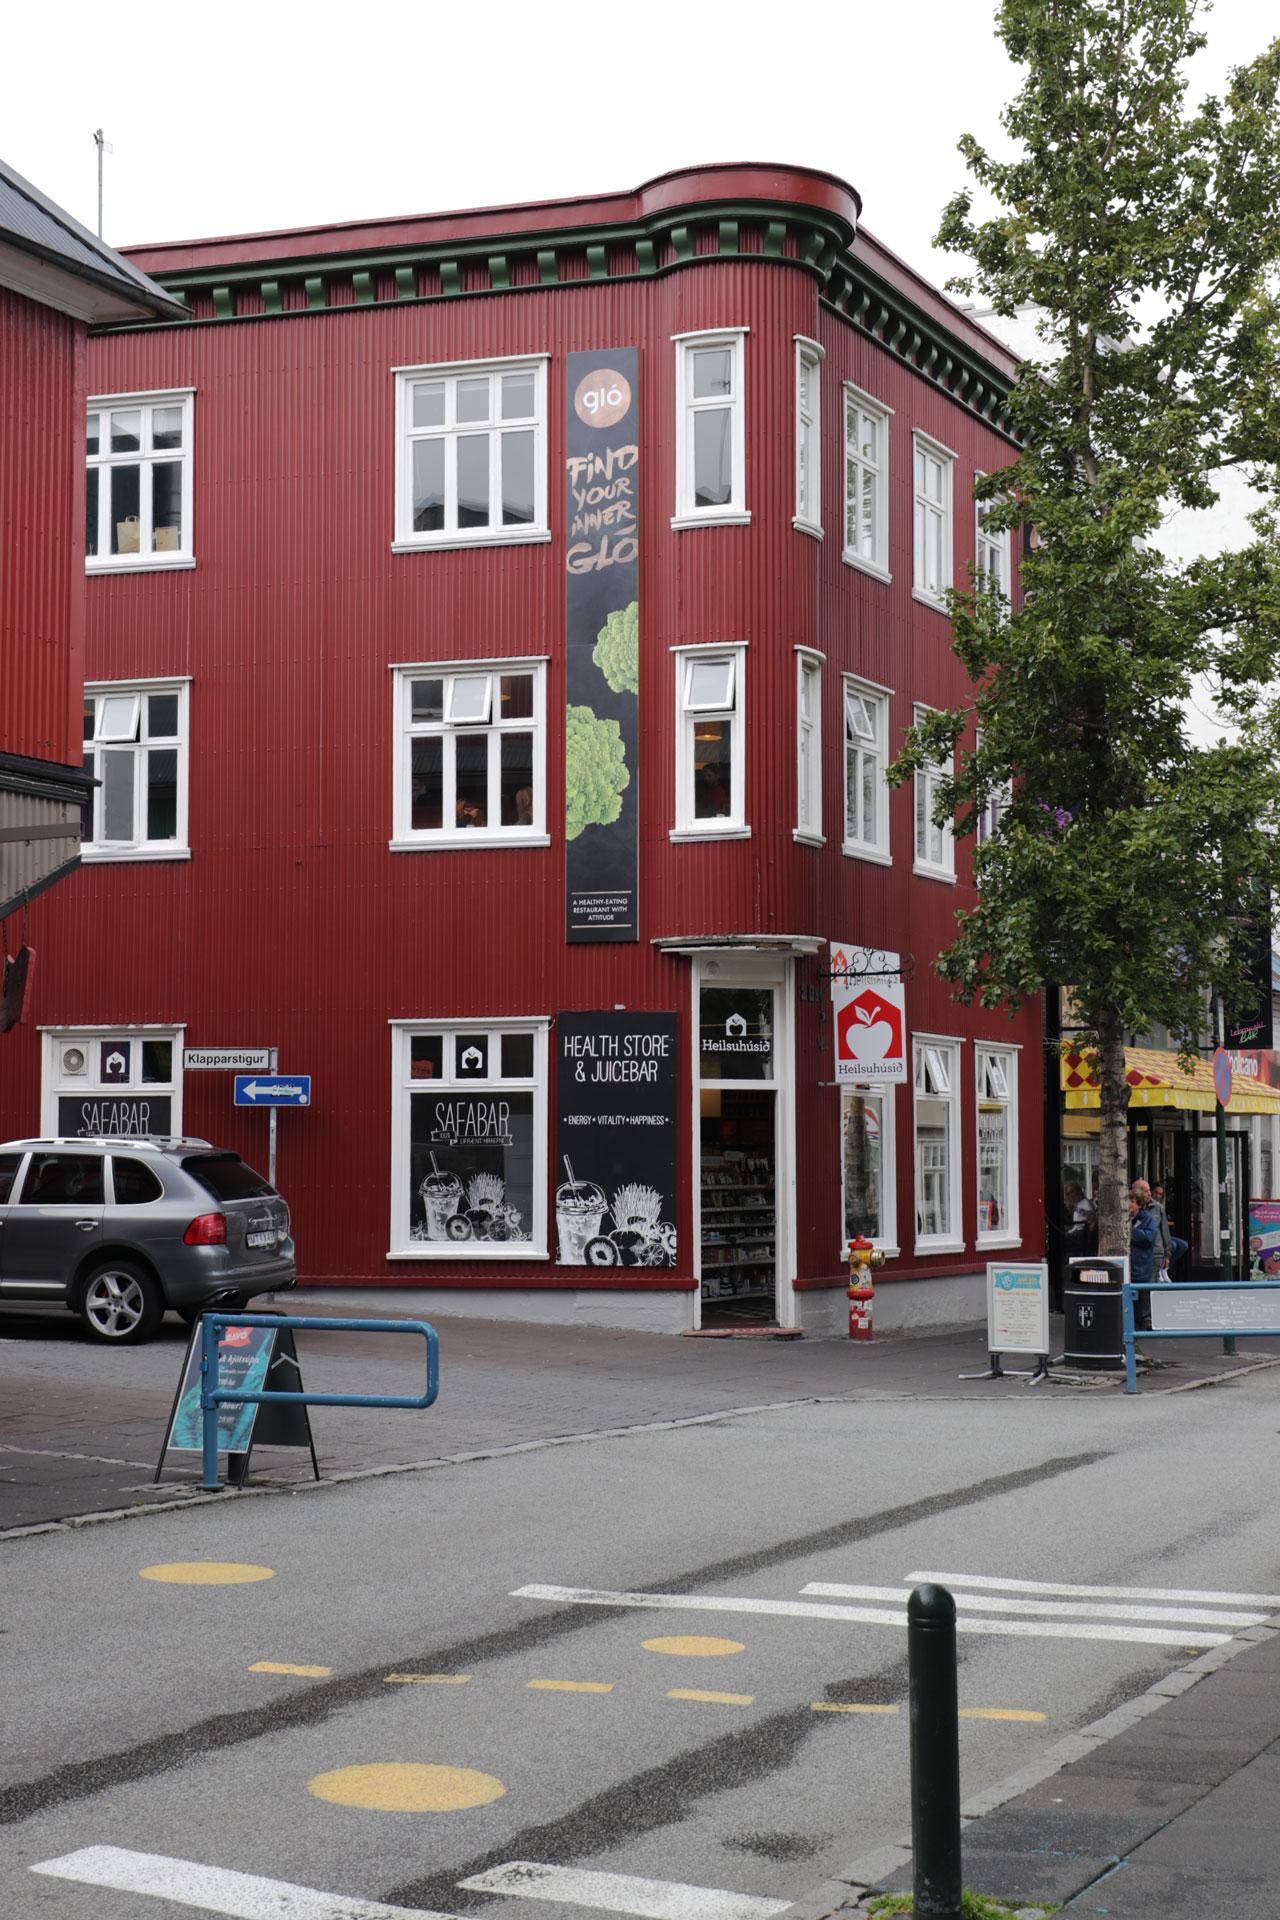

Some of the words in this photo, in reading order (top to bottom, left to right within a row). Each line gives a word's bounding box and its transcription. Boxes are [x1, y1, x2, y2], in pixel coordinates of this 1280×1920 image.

[583, 384, 623, 414] gló
[572, 477, 635, 512] YOUR
[566, 523, 639, 574] GLÓ
[578, 898, 628, 906] HEALTHY-EATING
[573, 906, 610, 914] RESTAURANT
[1239, 1029, 1259, 1043] BAR
[564, 1035, 619, 1057] HEALTH
[623, 1034, 670, 1057] STORE
[702, 1039, 771, 1052] Heilsuhúsið
[187, 1053, 265, 1067] Klapparstígur
[574, 1060, 586, 1082] &
[591, 1060, 658, 1082] JUICEBAR
[838, 1062, 904, 1074] Heilsuhúsið
[82, 1102, 150, 1136] SAFABAR
[435, 1102, 510, 1136] SAFABAR
[568, 1115, 592, 1125] ENERGY
[597, 1115, 626, 1125] VITALITY
[629, 1115, 665, 1125] HAPPINESS
[224, 1329, 248, 1341] RAVÓ
